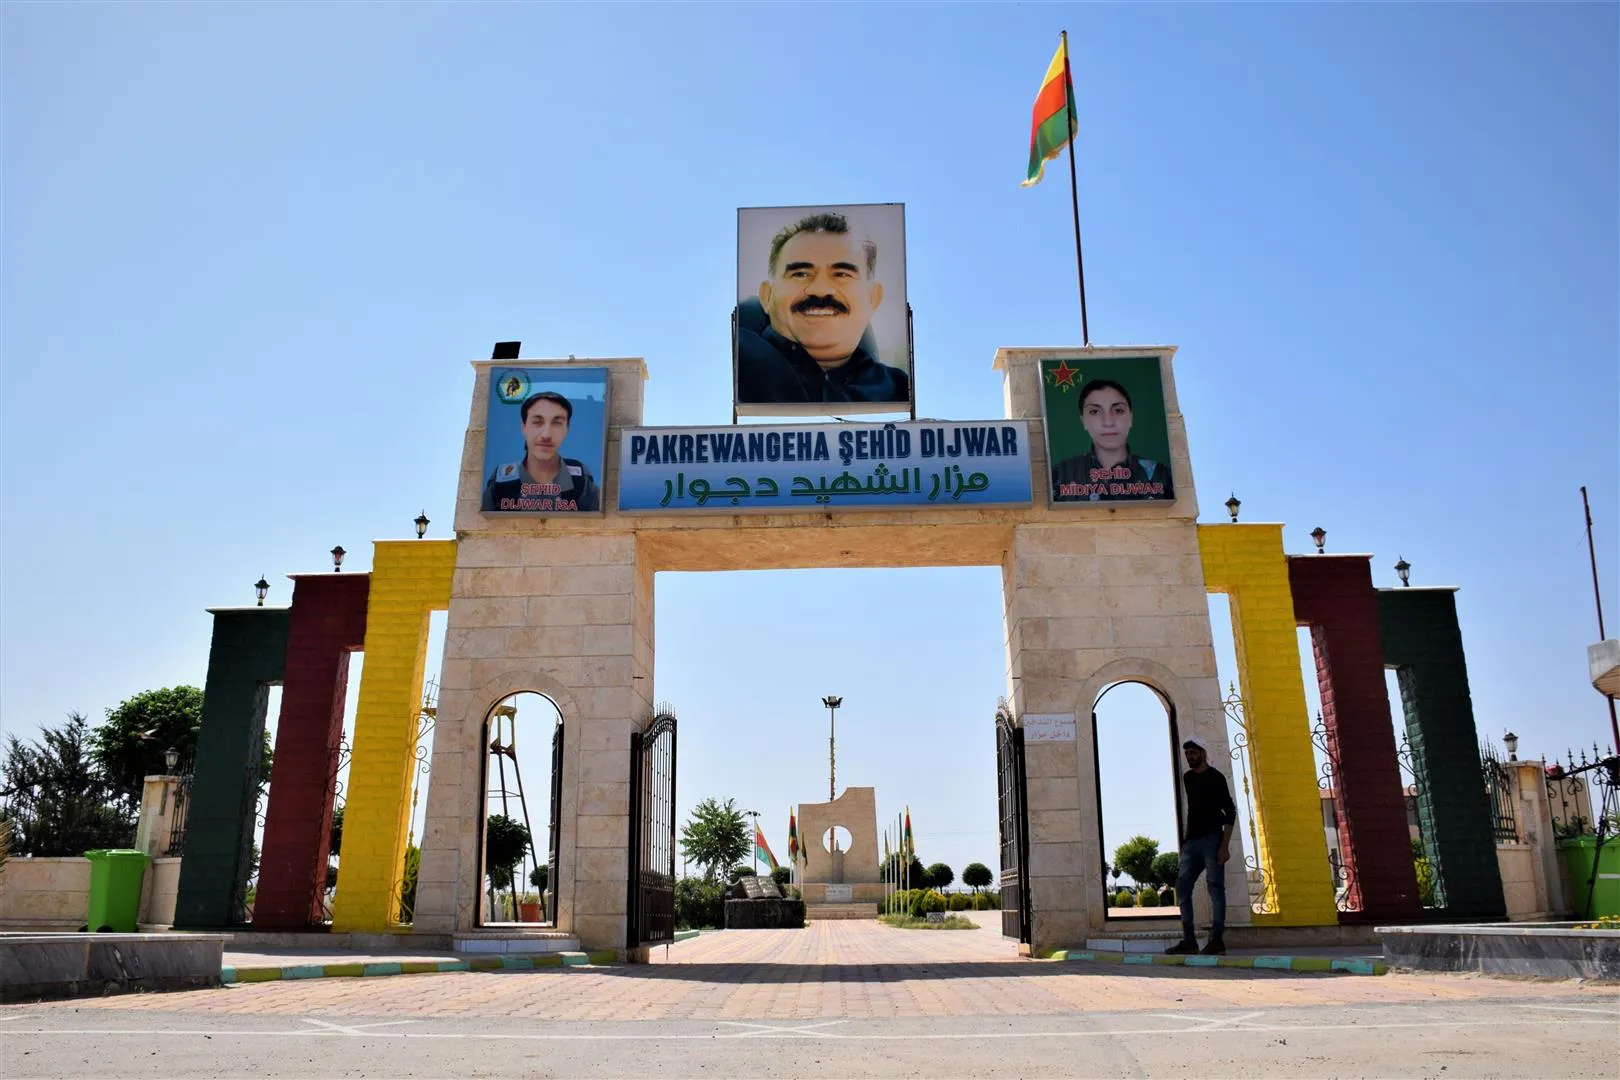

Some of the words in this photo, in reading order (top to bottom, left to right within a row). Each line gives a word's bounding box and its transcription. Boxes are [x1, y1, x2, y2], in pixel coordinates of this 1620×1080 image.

[631, 431, 830, 465] PAKREWANGEHA
[838, 423, 911, 466] ŞEHÎD
[920, 427, 1018, 458] DIJWAR
[660, 472, 779, 506] دجوار
[790, 462, 920, 503] الشهيد
[926, 464, 989, 501] مزار
[500, 498, 553, 511] DIJWAR
